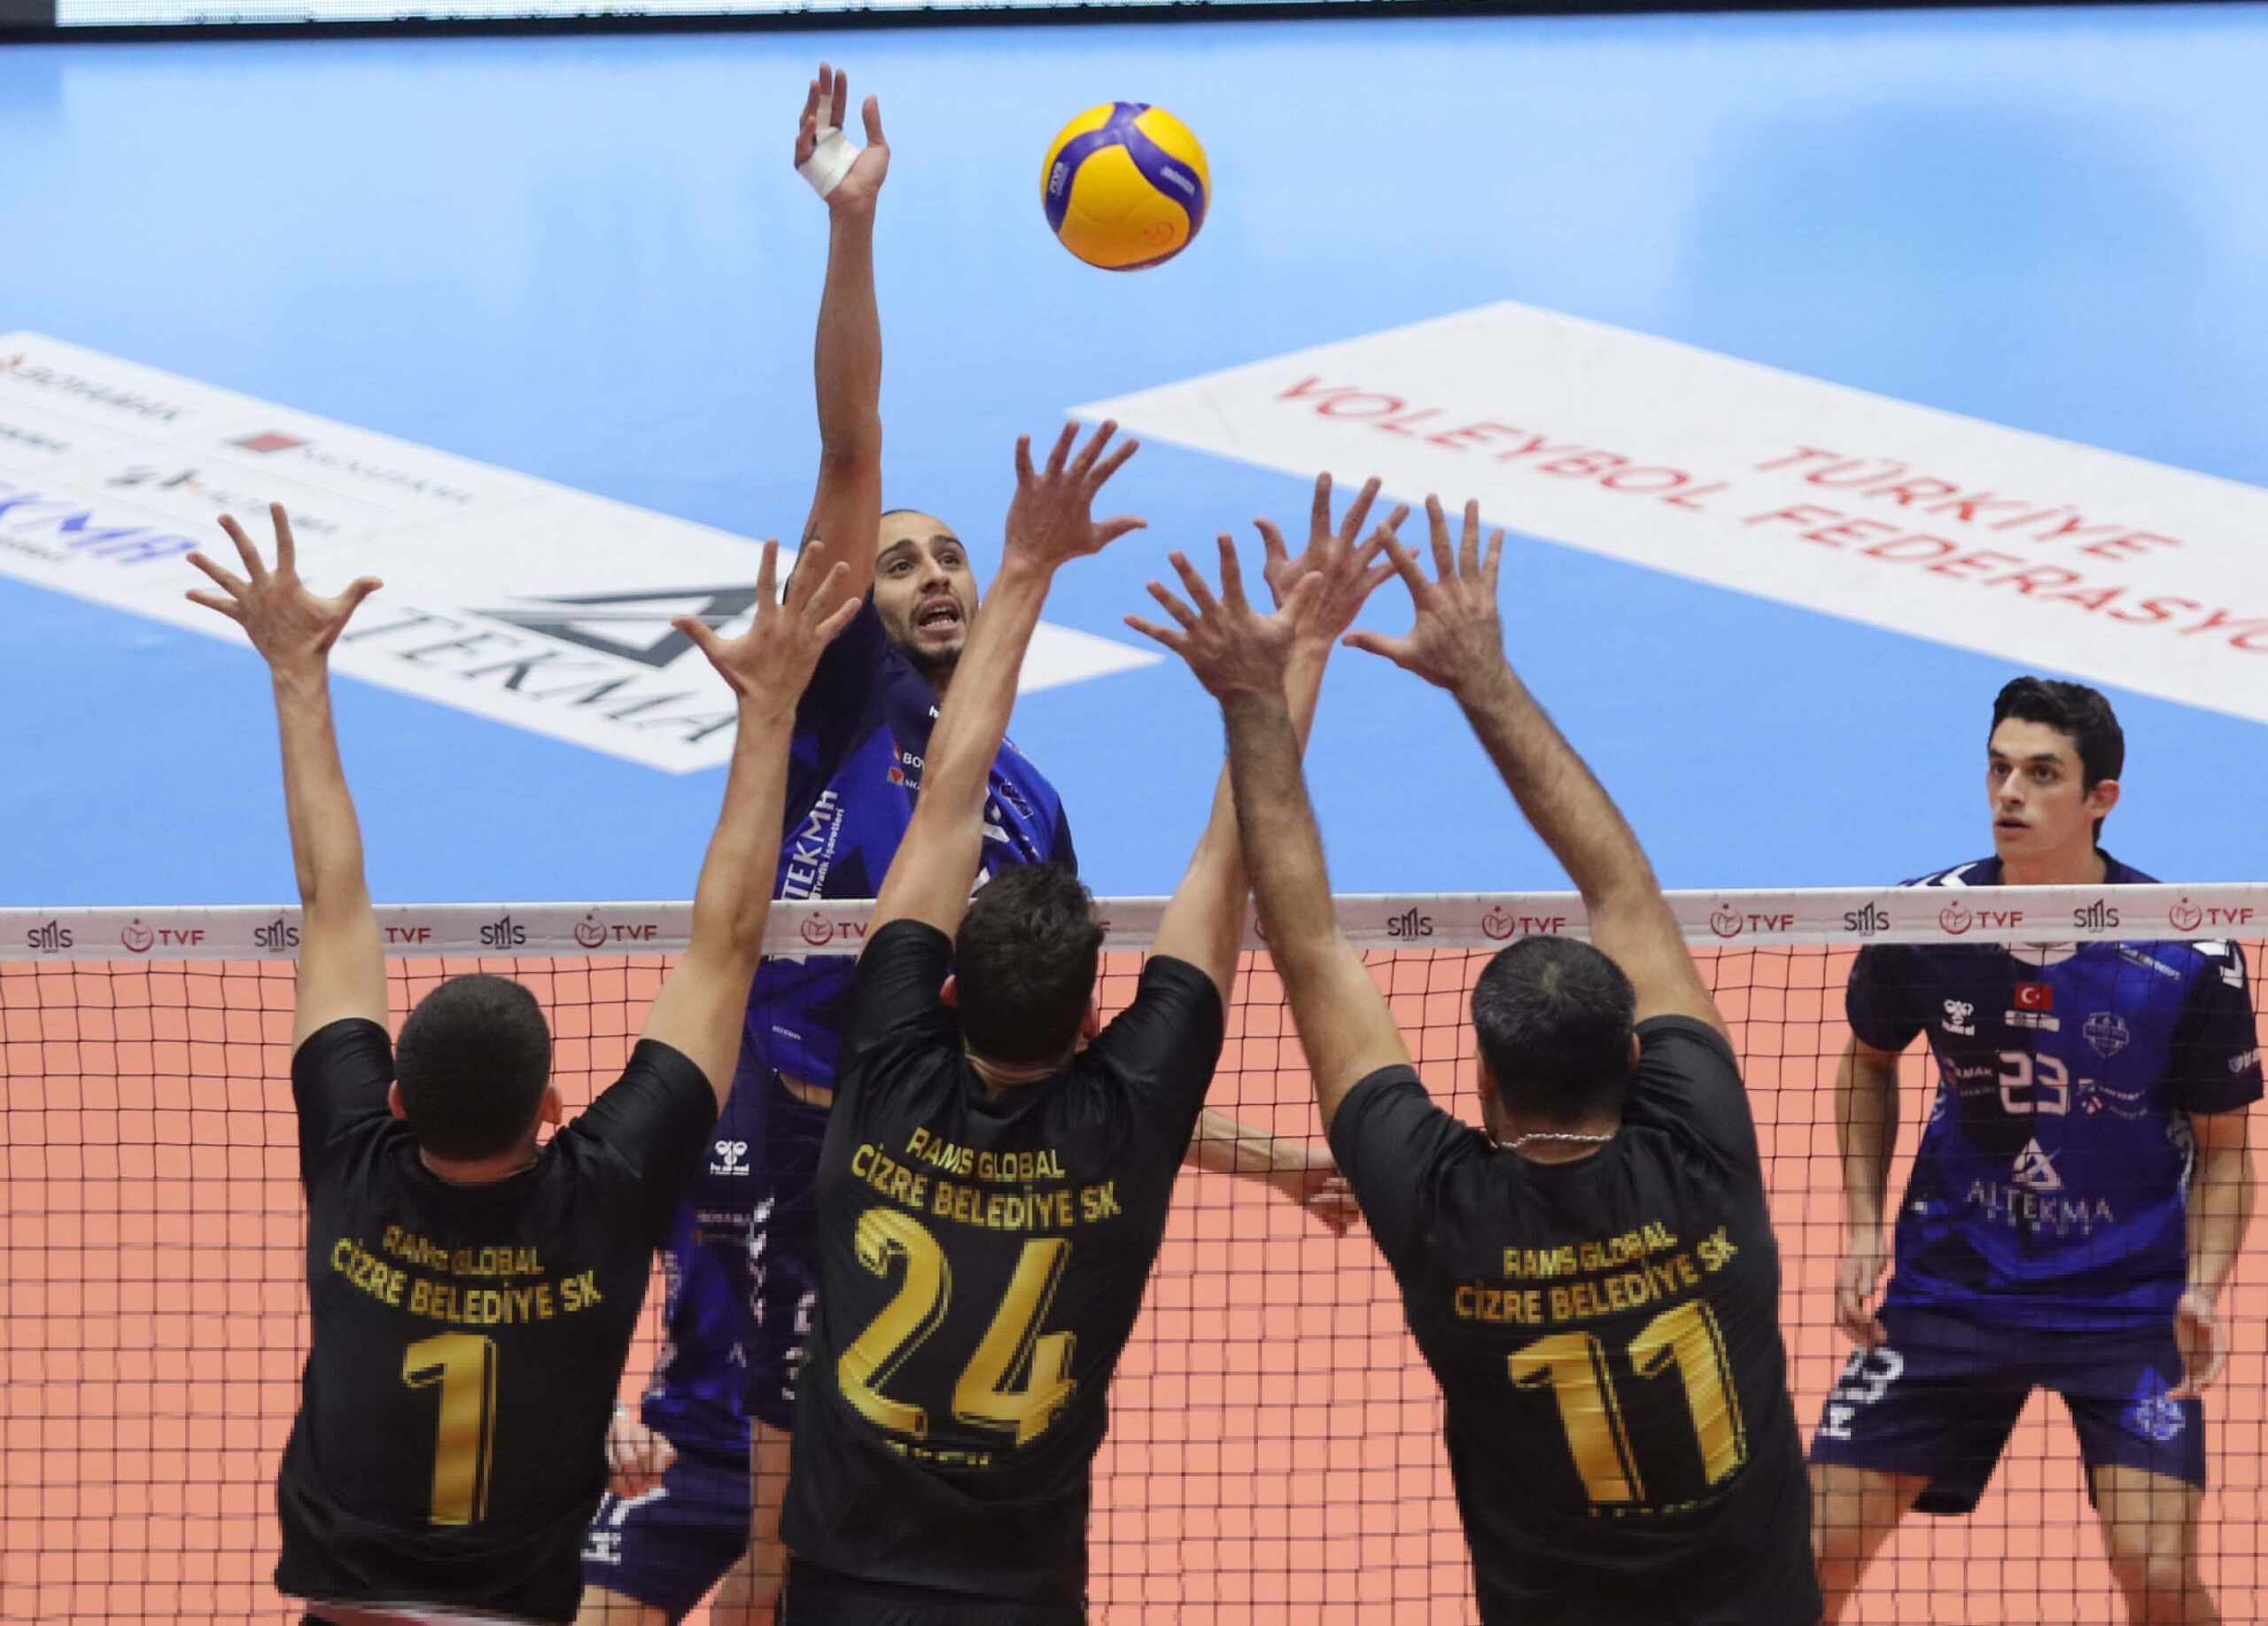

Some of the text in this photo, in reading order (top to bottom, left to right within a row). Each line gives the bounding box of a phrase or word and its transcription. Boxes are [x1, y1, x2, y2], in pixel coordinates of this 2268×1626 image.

[1276, 376, 1728, 511] VOLEYBOL
[1754, 445, 2181, 562] TÜRKİYE
[158, 930, 205, 945] TVF
[384, 927, 431, 944] TVF
[611, 925, 657, 941] TVF
[838, 922, 867, 939] TV
[1519, 917, 1566, 933] TVF
[1748, 914, 1794, 930] TVF
[1977, 911, 2023, 928] TVF
[2207, 907, 2254, 924] TVF
[1998, 1049, 2070, 1116] 23
[906, 1127, 1066, 1181] RAMS GLOBAL
[851, 1143, 1122, 1231] CİZRE BELEDİYE SK
[1697, 1225, 1739, 1272] SK
[407, 1278, 556, 1324] BELEDİYE
[560, 1270, 604, 1312] SK
[836, 1205, 1077, 1447] 24
[1506, 1298, 1747, 1502] 11
[402, 1331, 498, 1525] 1
